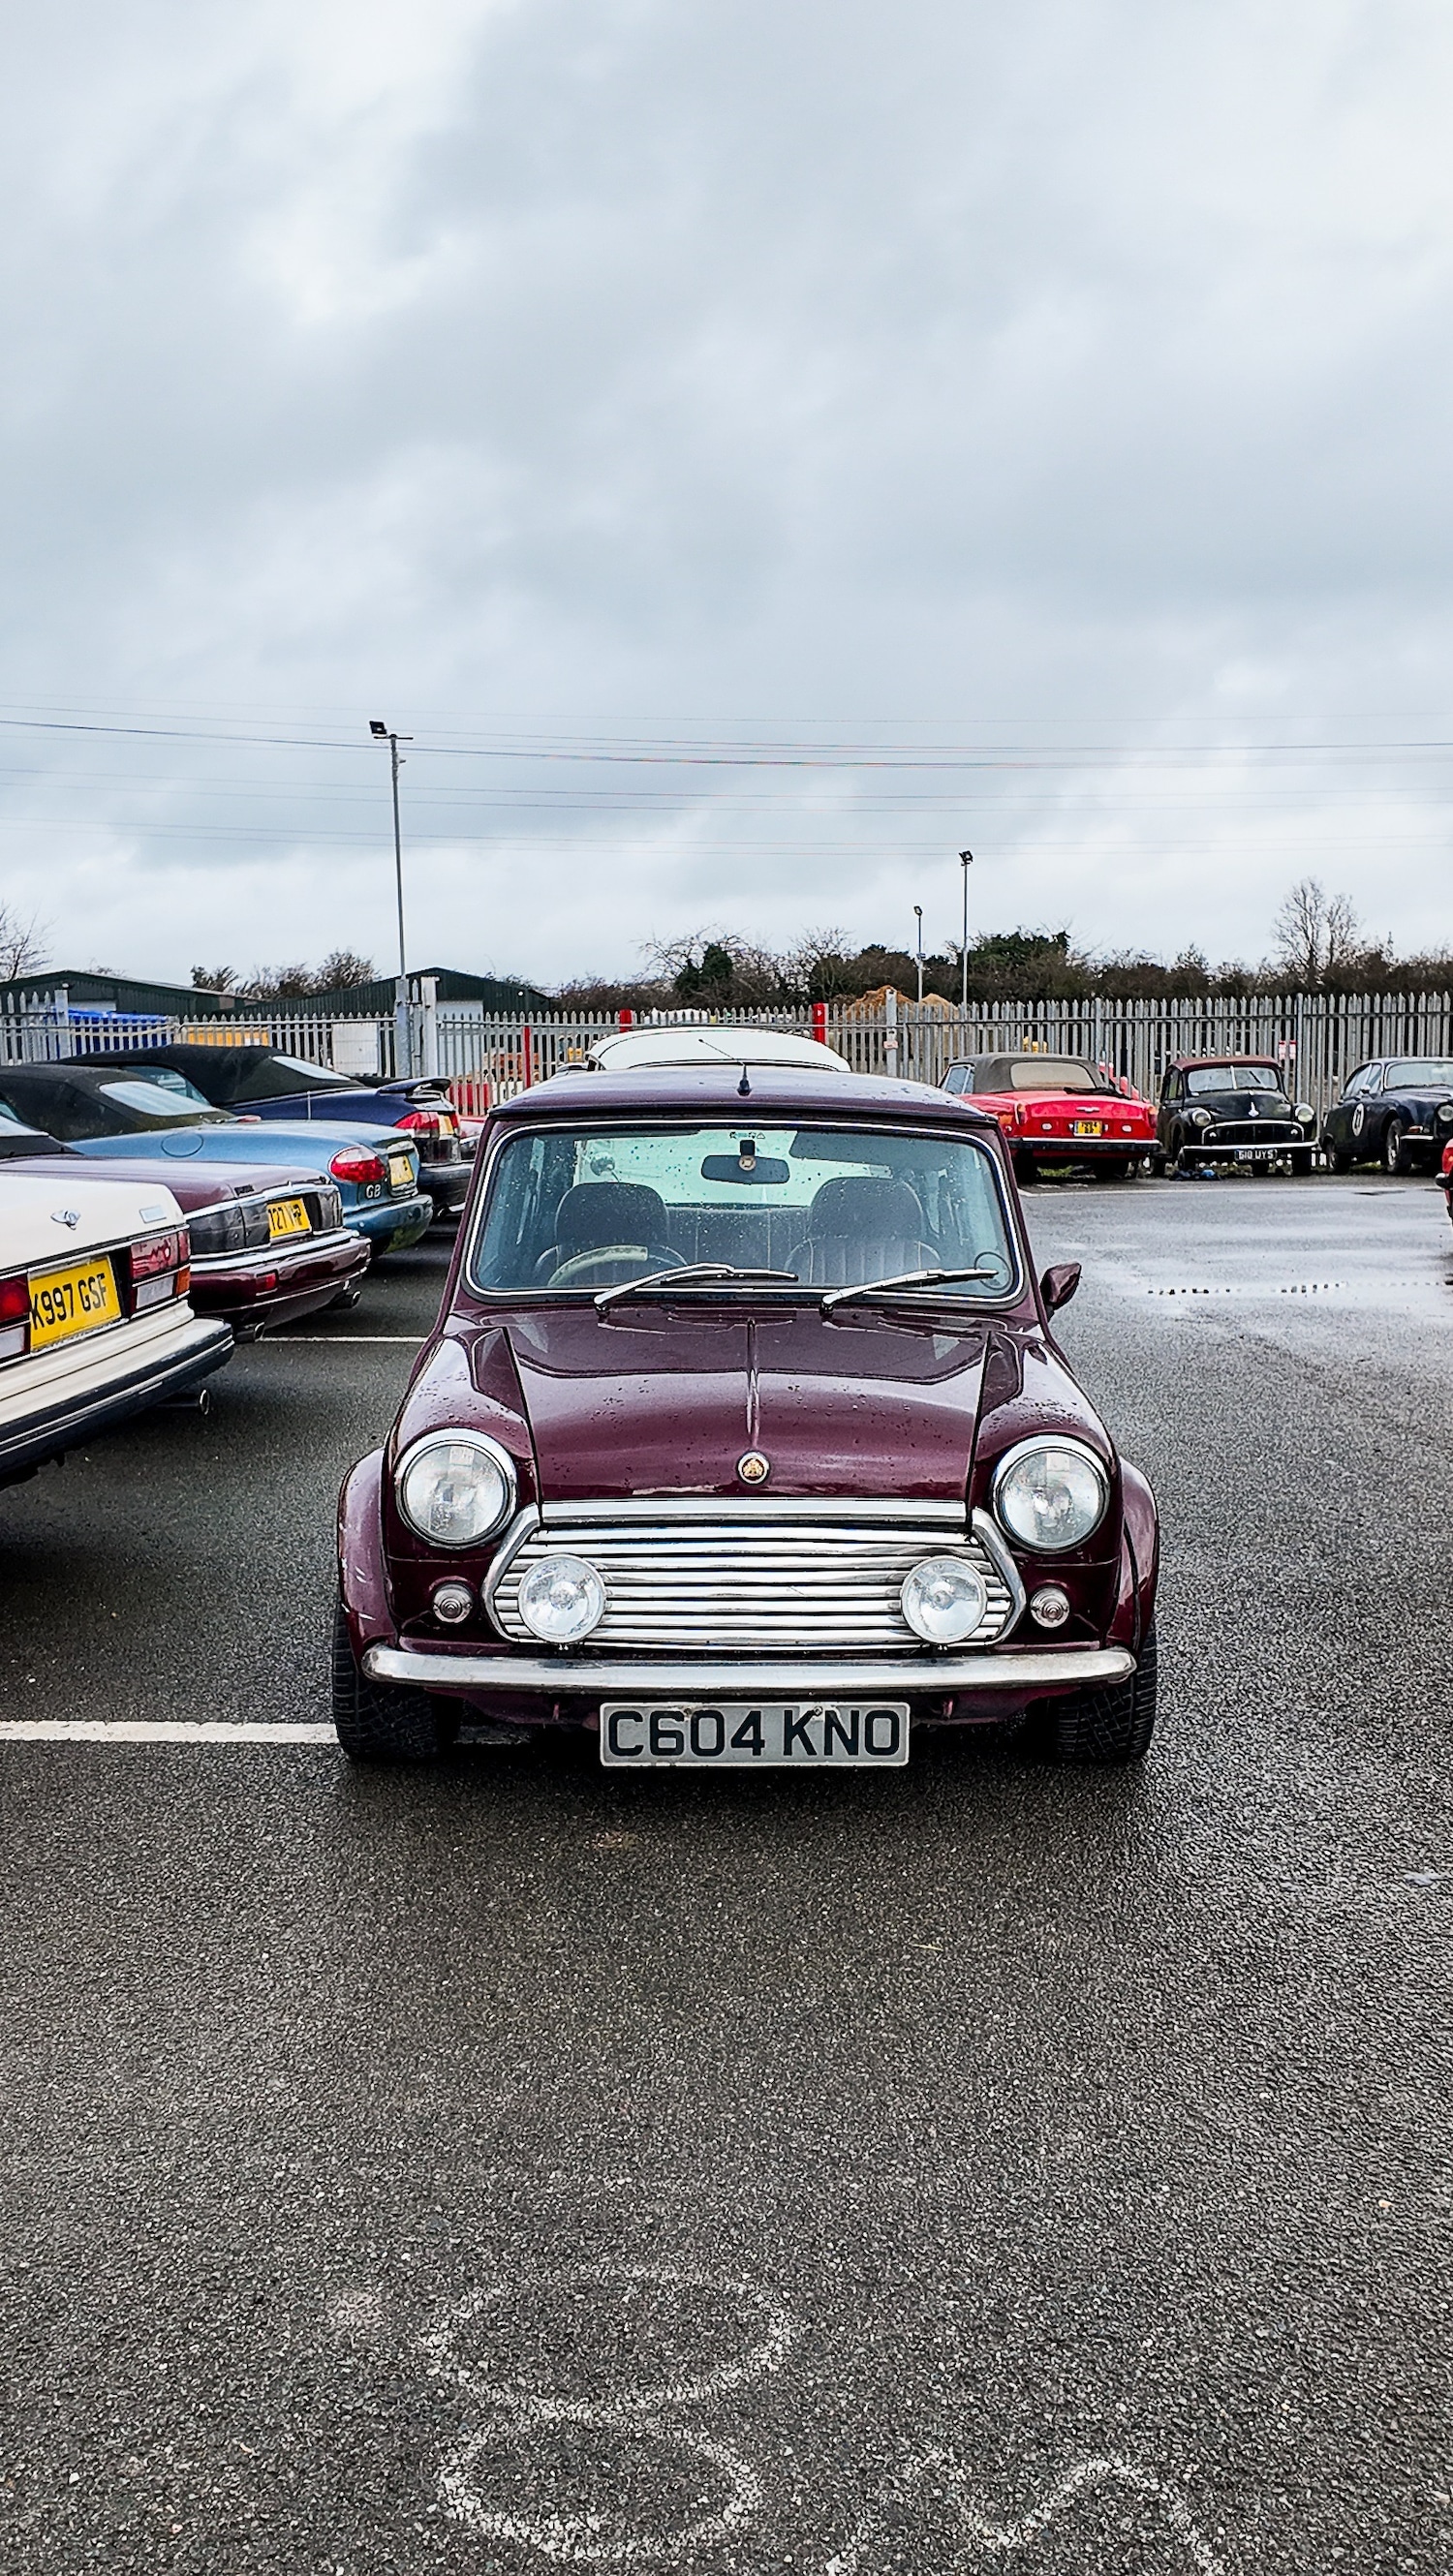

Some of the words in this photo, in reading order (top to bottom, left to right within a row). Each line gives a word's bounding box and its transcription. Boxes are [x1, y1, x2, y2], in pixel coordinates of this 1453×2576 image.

[366, 1183, 382, 1199] GB
[30, 1282, 75, 1331] K997
[77, 1273, 107, 1312] GSF
[607, 1709, 766, 1757] C604
[782, 1709, 901, 1757] KNO
